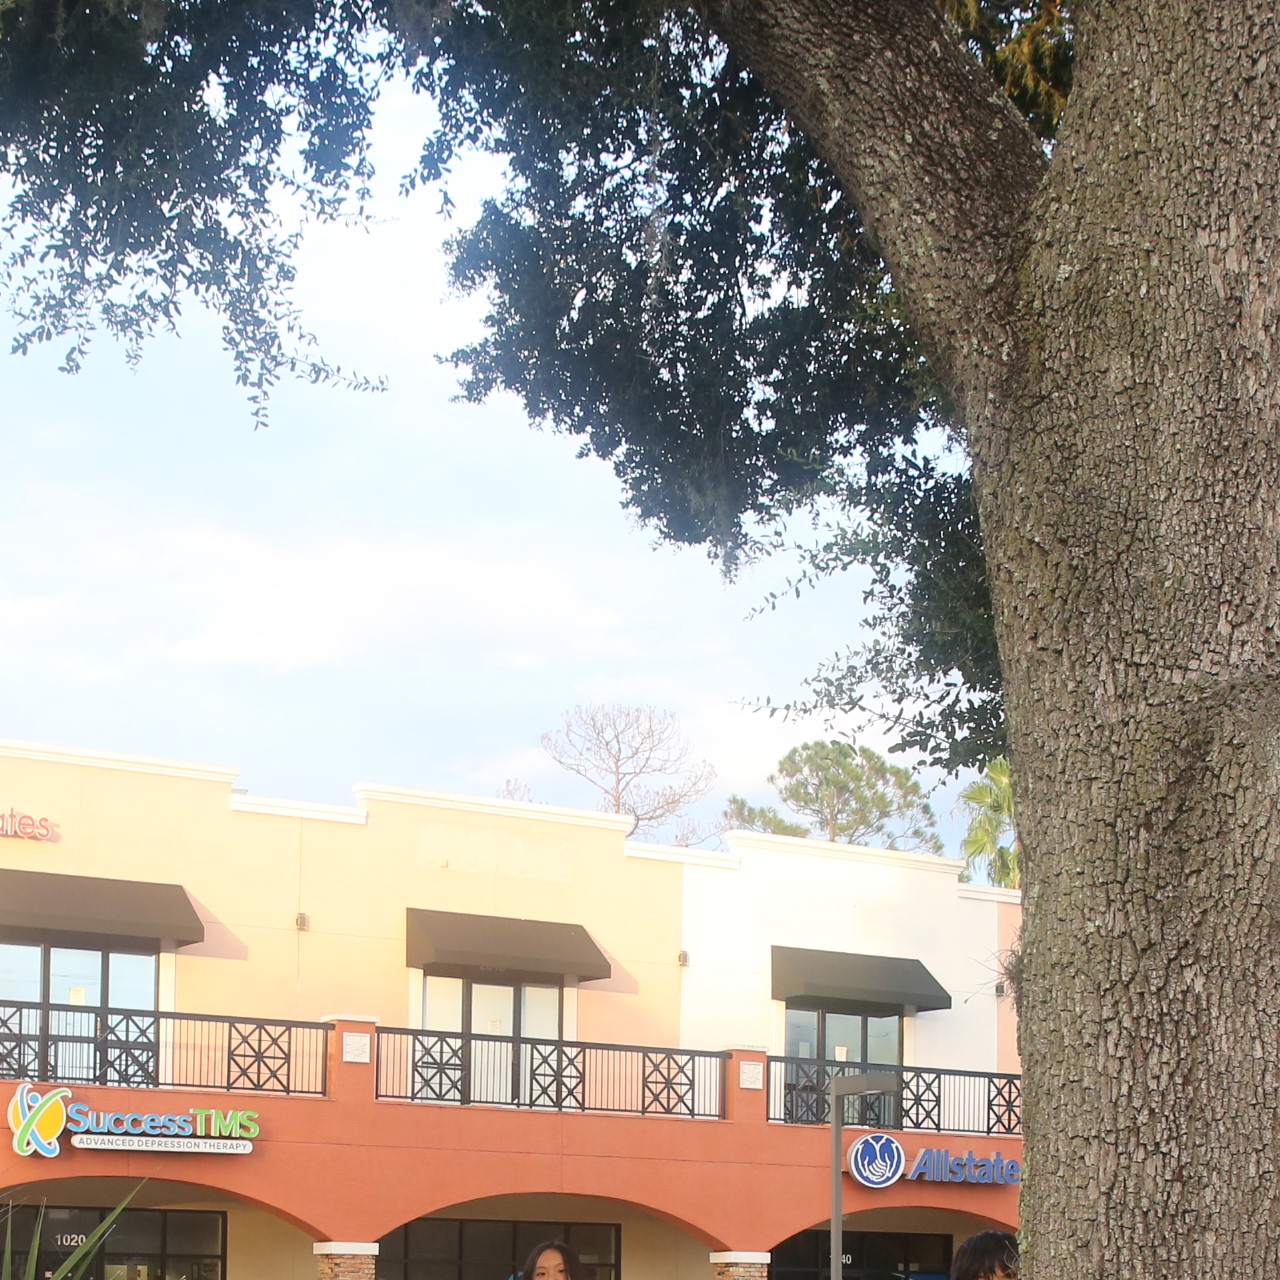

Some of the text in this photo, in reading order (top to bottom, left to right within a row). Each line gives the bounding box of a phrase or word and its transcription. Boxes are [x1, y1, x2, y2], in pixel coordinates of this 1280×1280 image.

[67, 1103, 261, 1138] SuccessTMS
[77, 1137, 249, 1151] ADVANCED DEPRESSION THERAPY
[907, 1148, 1022, 1184] Allstate
[55, 1234, 86, 1246] 1020
